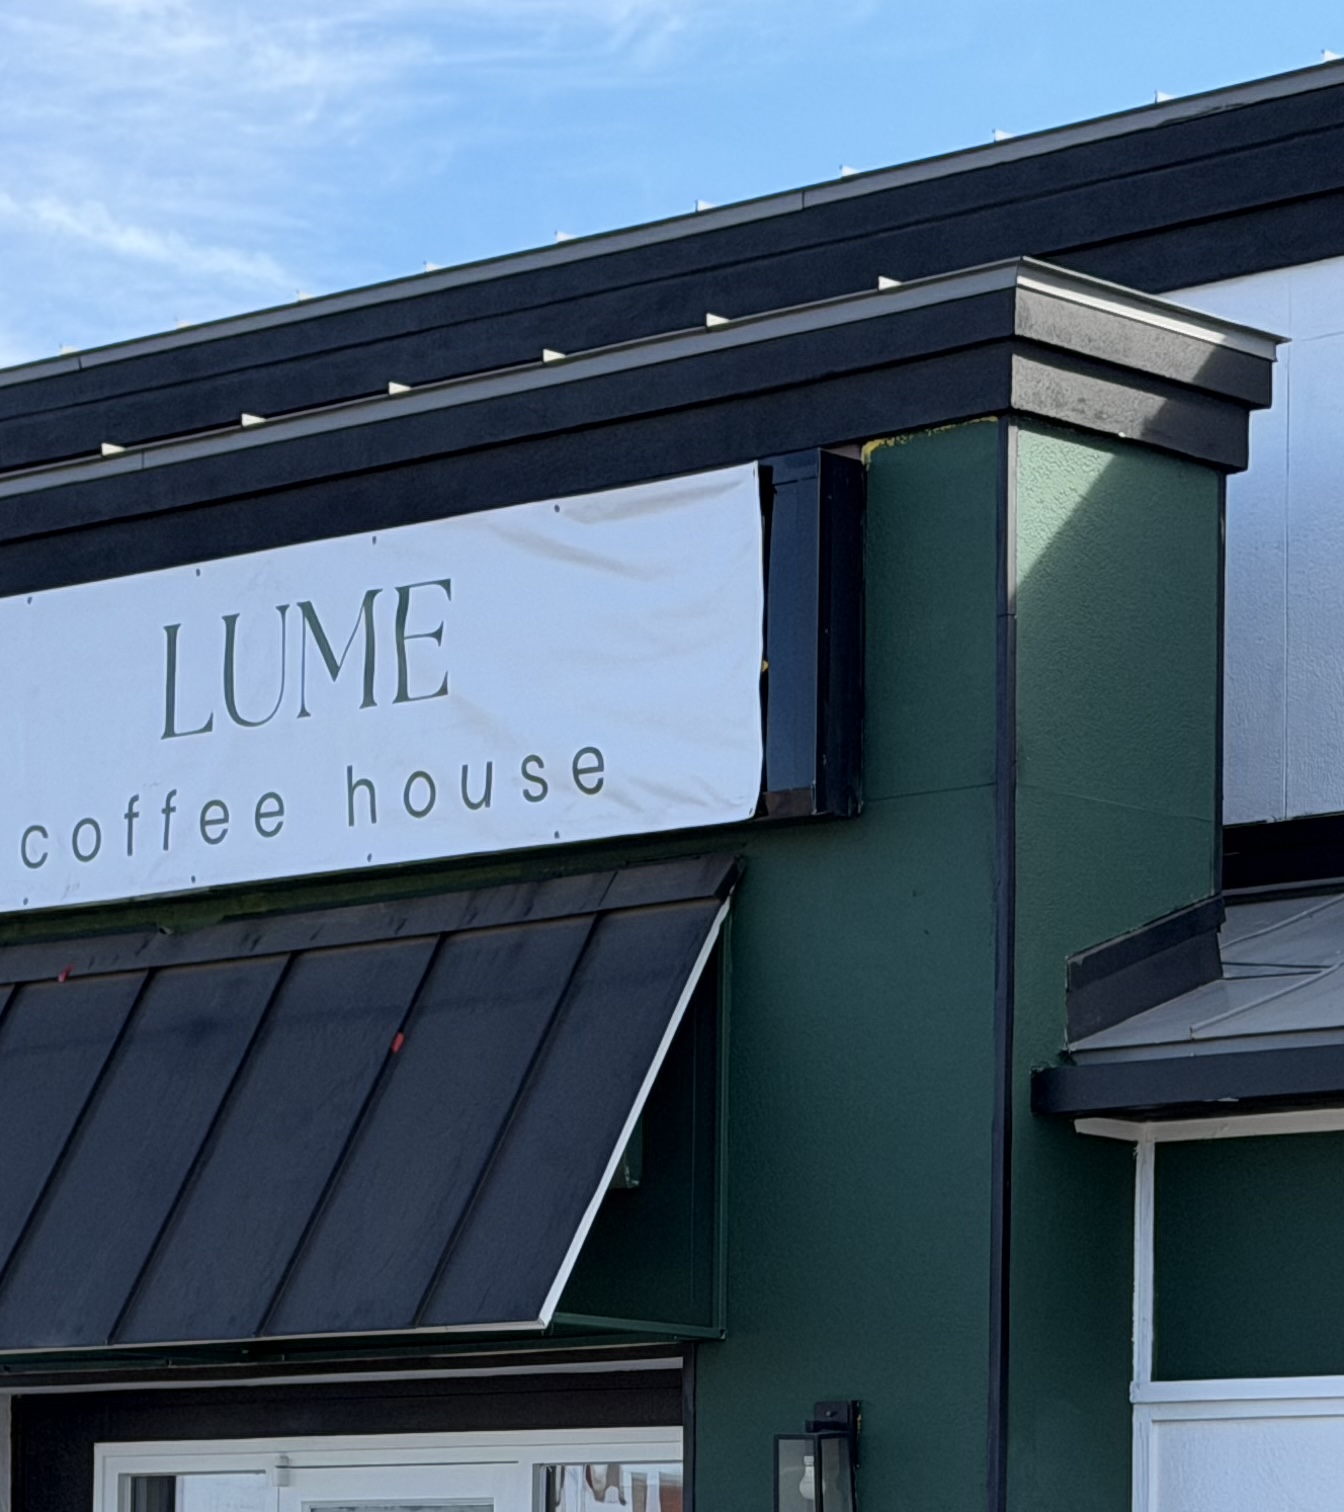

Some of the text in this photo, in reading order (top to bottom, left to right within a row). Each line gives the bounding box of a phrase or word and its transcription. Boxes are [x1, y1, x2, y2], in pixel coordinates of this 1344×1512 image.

[160, 577, 453, 741] LUME
[19, 745, 606, 870] coffee house
